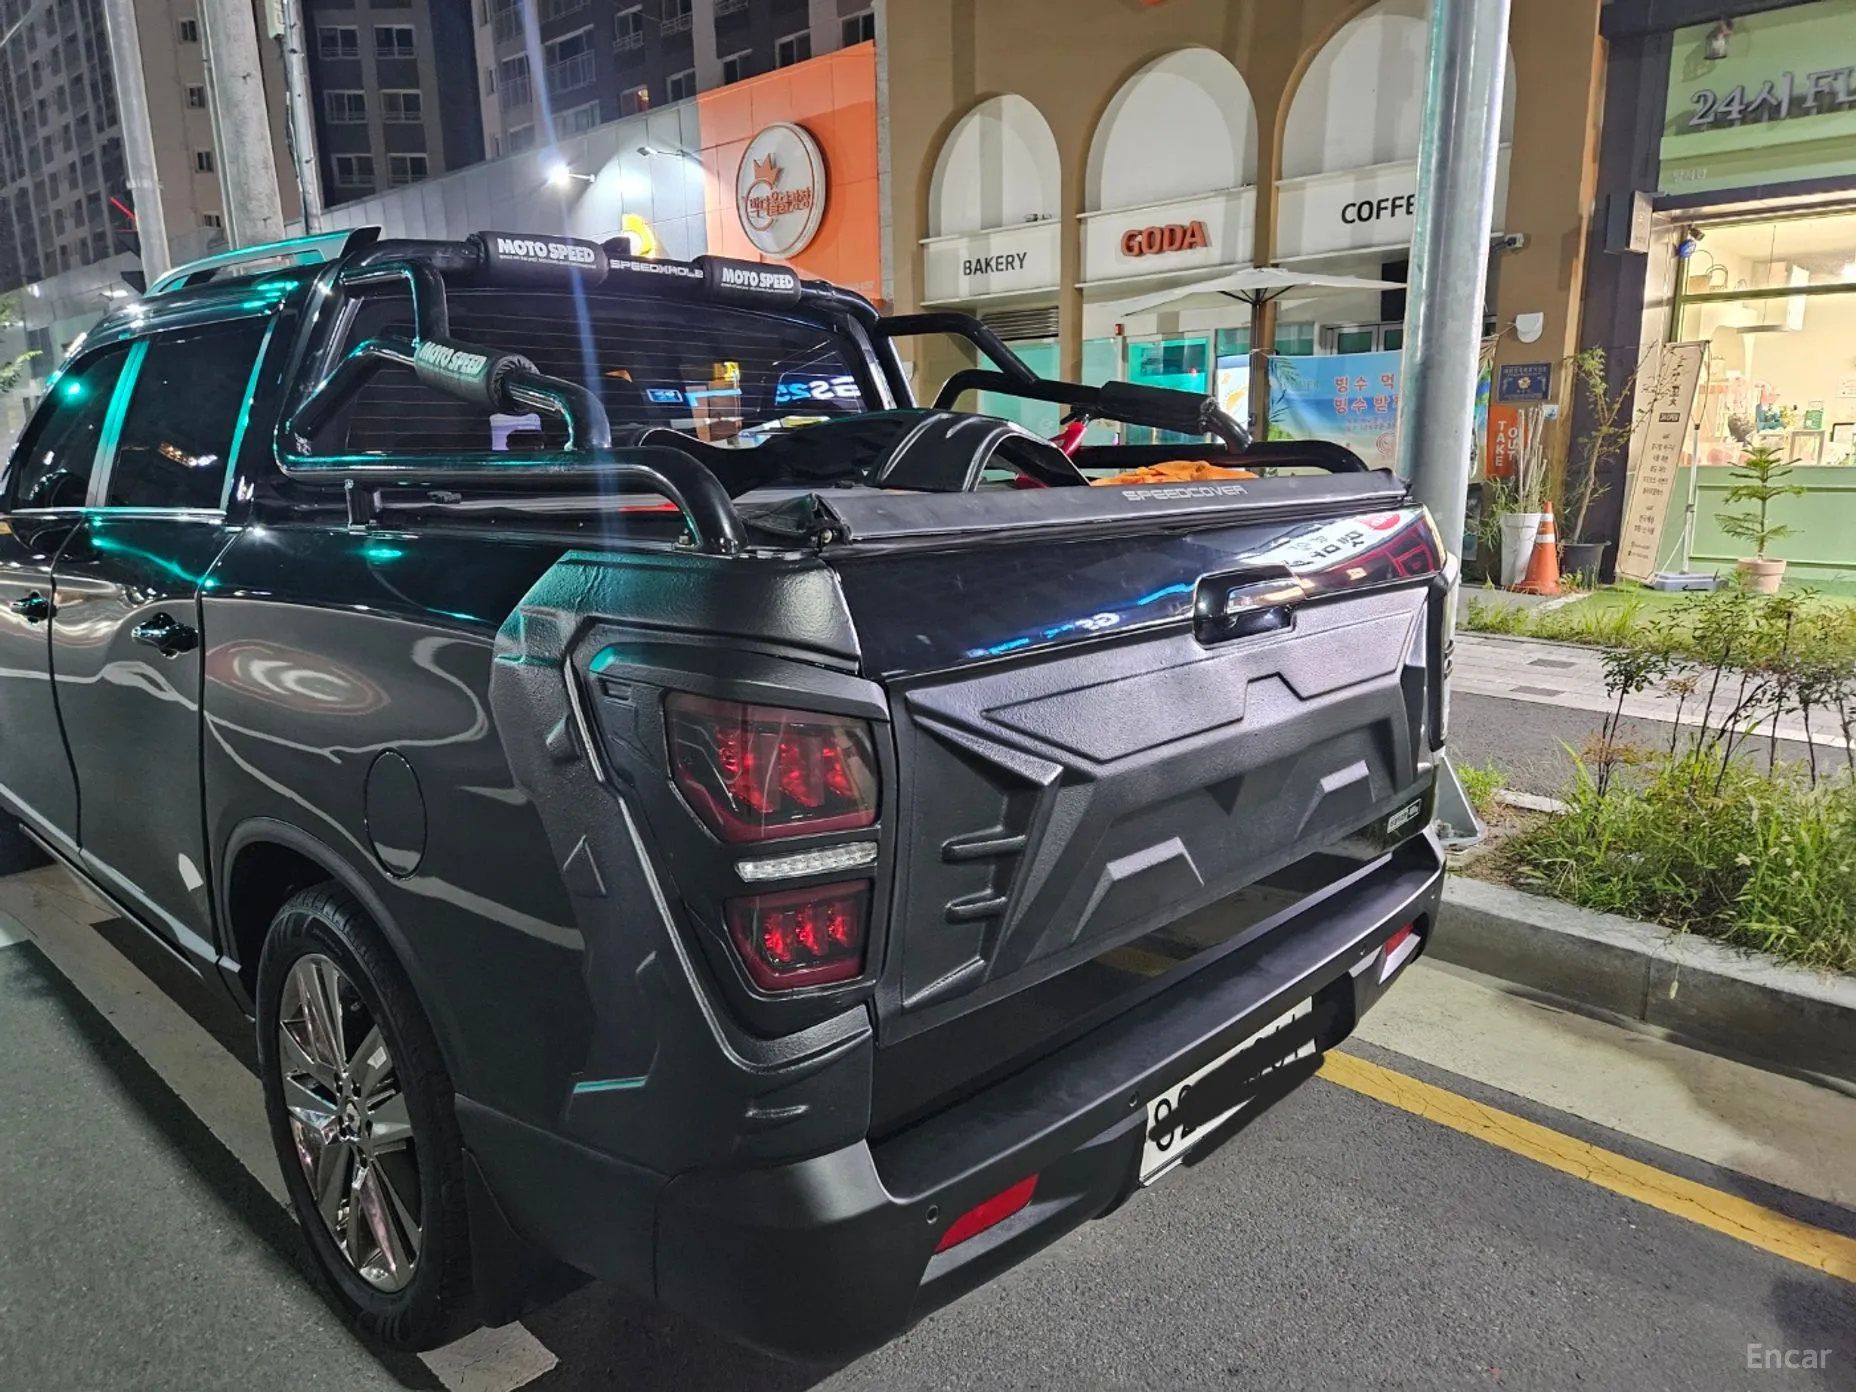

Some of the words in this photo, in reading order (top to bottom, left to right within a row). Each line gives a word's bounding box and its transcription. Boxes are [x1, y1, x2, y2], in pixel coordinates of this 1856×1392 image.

[1689, 71, 1794, 126] 24시
[497, 237, 548, 258] MOTO
[548, 242, 596, 263] SPEED
[1121, 220, 1208, 257] GODA
[963, 252, 1027, 276] BAKERY
[722, 267, 759, 287] MOTO
[759, 272, 794, 290] SPEED
[420, 341, 455, 368] MOTO
[448, 351, 488, 375] SPEED
[1334, 375, 1368, 393] 빙수
[1334, 396, 1368, 414] 빙수
[1495, 420, 1508, 467] TAKE
[1507, 426, 1519, 462] OUT
[1121, 484, 1249, 501] SPEEDCOVER
